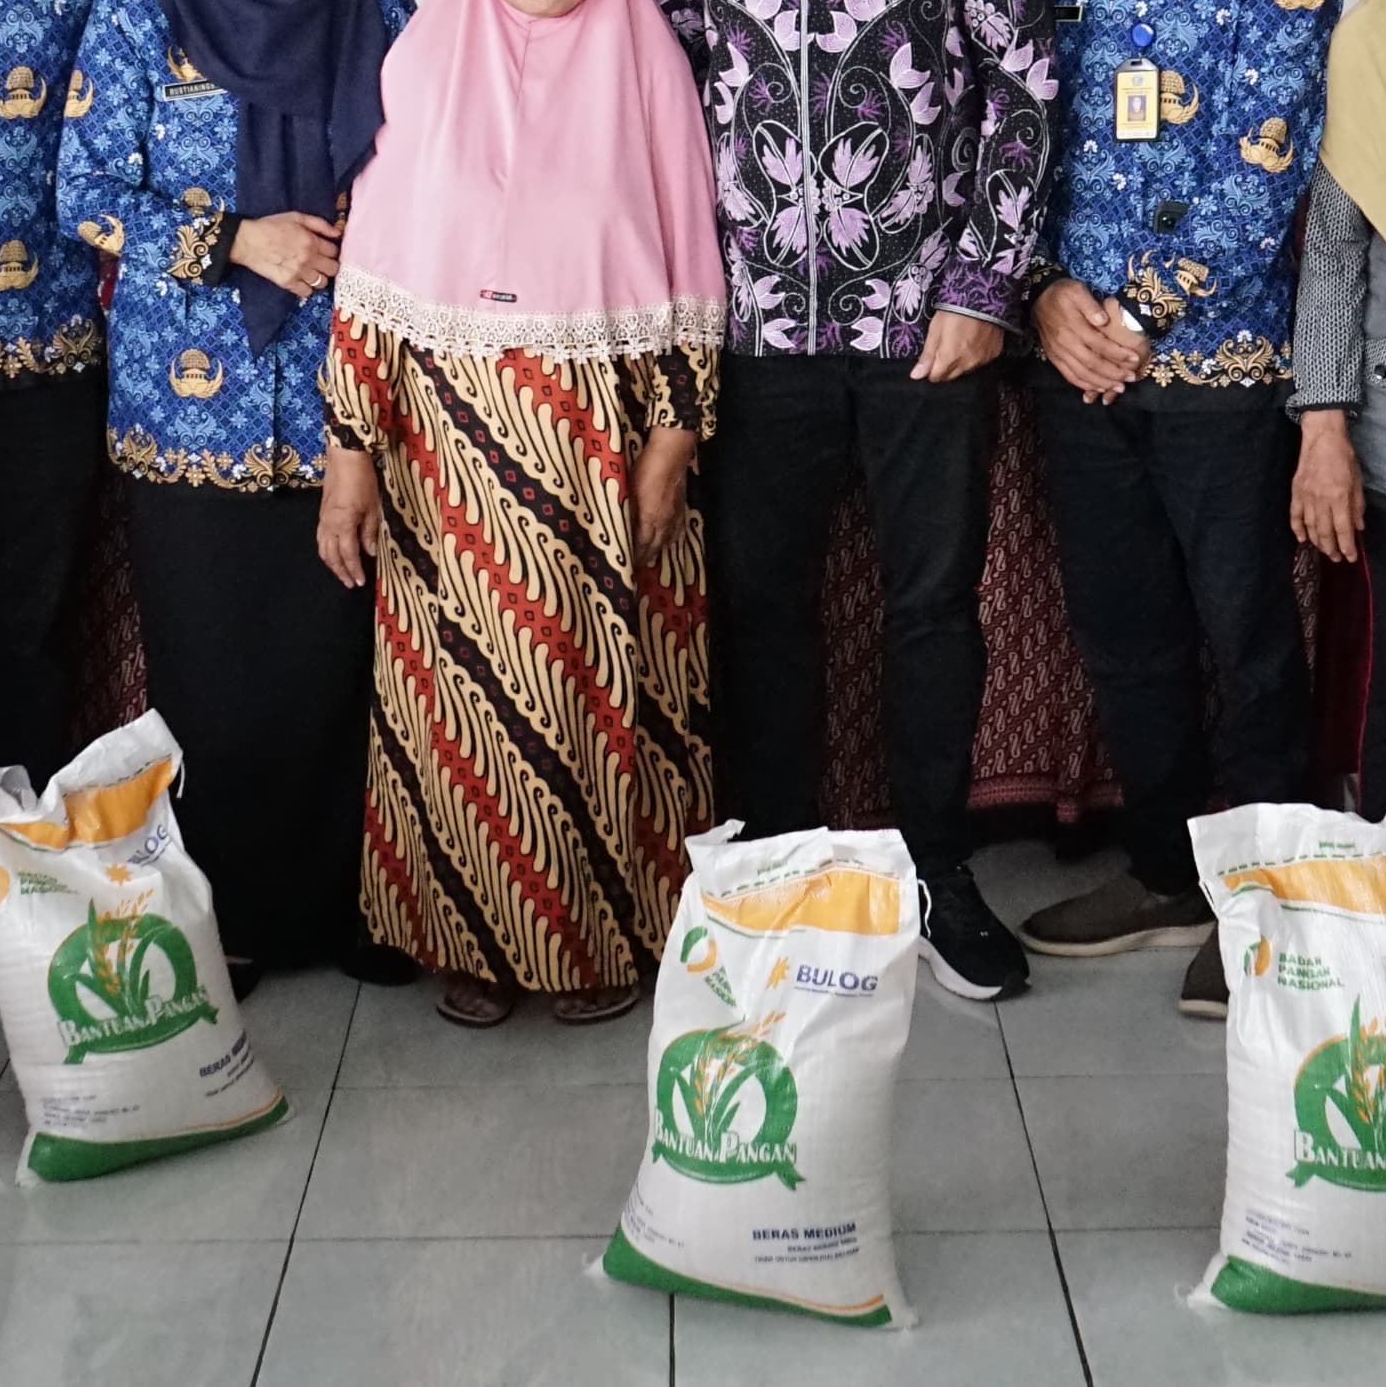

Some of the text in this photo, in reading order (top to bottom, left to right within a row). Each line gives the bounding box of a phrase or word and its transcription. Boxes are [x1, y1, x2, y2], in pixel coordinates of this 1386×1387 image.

[796, 965, 878, 992] BULOG
[1277, 976, 1344, 991] NASIONAL
[654, 1108, 797, 1163] BANTUAN PANGAN
[803, 1221, 856, 1239] MEDIUM
